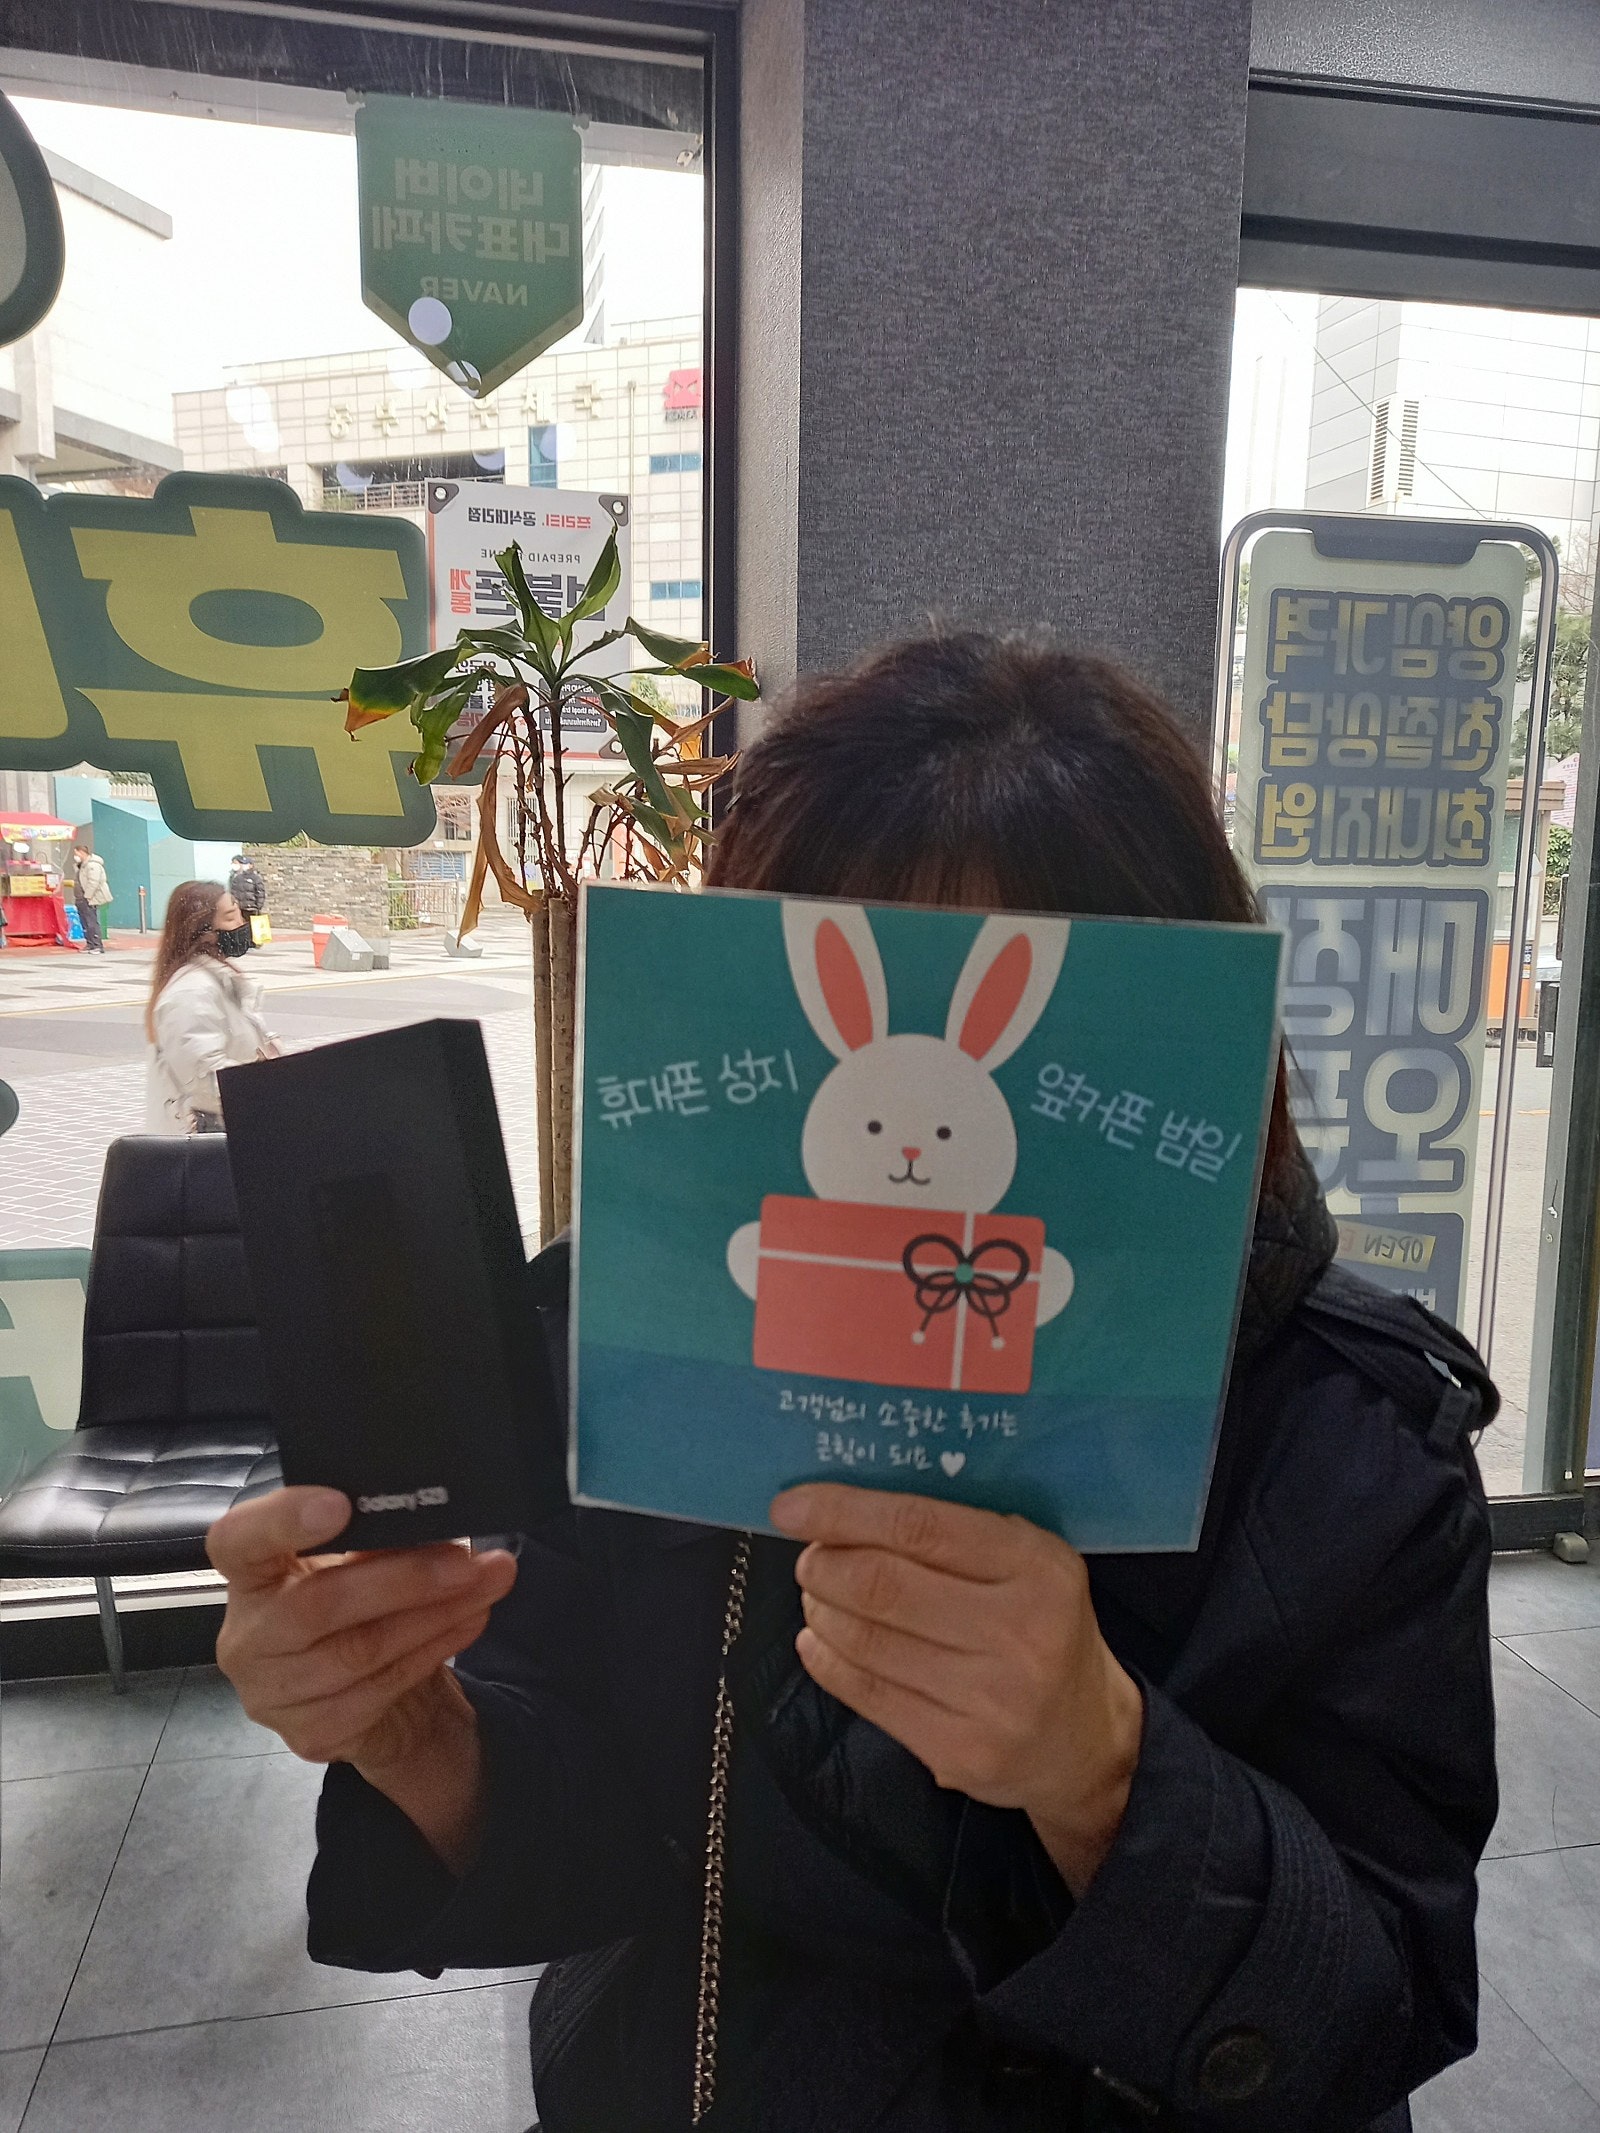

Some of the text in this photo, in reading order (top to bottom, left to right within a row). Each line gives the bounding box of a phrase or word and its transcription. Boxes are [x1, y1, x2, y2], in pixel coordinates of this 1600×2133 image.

[596, 1047, 799, 1129] 휴대폰 성지
[1029, 1062, 1244, 1183] 옆커폰 범일
[779, 1389, 1018, 1439] 고객님의 소중한 후기는
